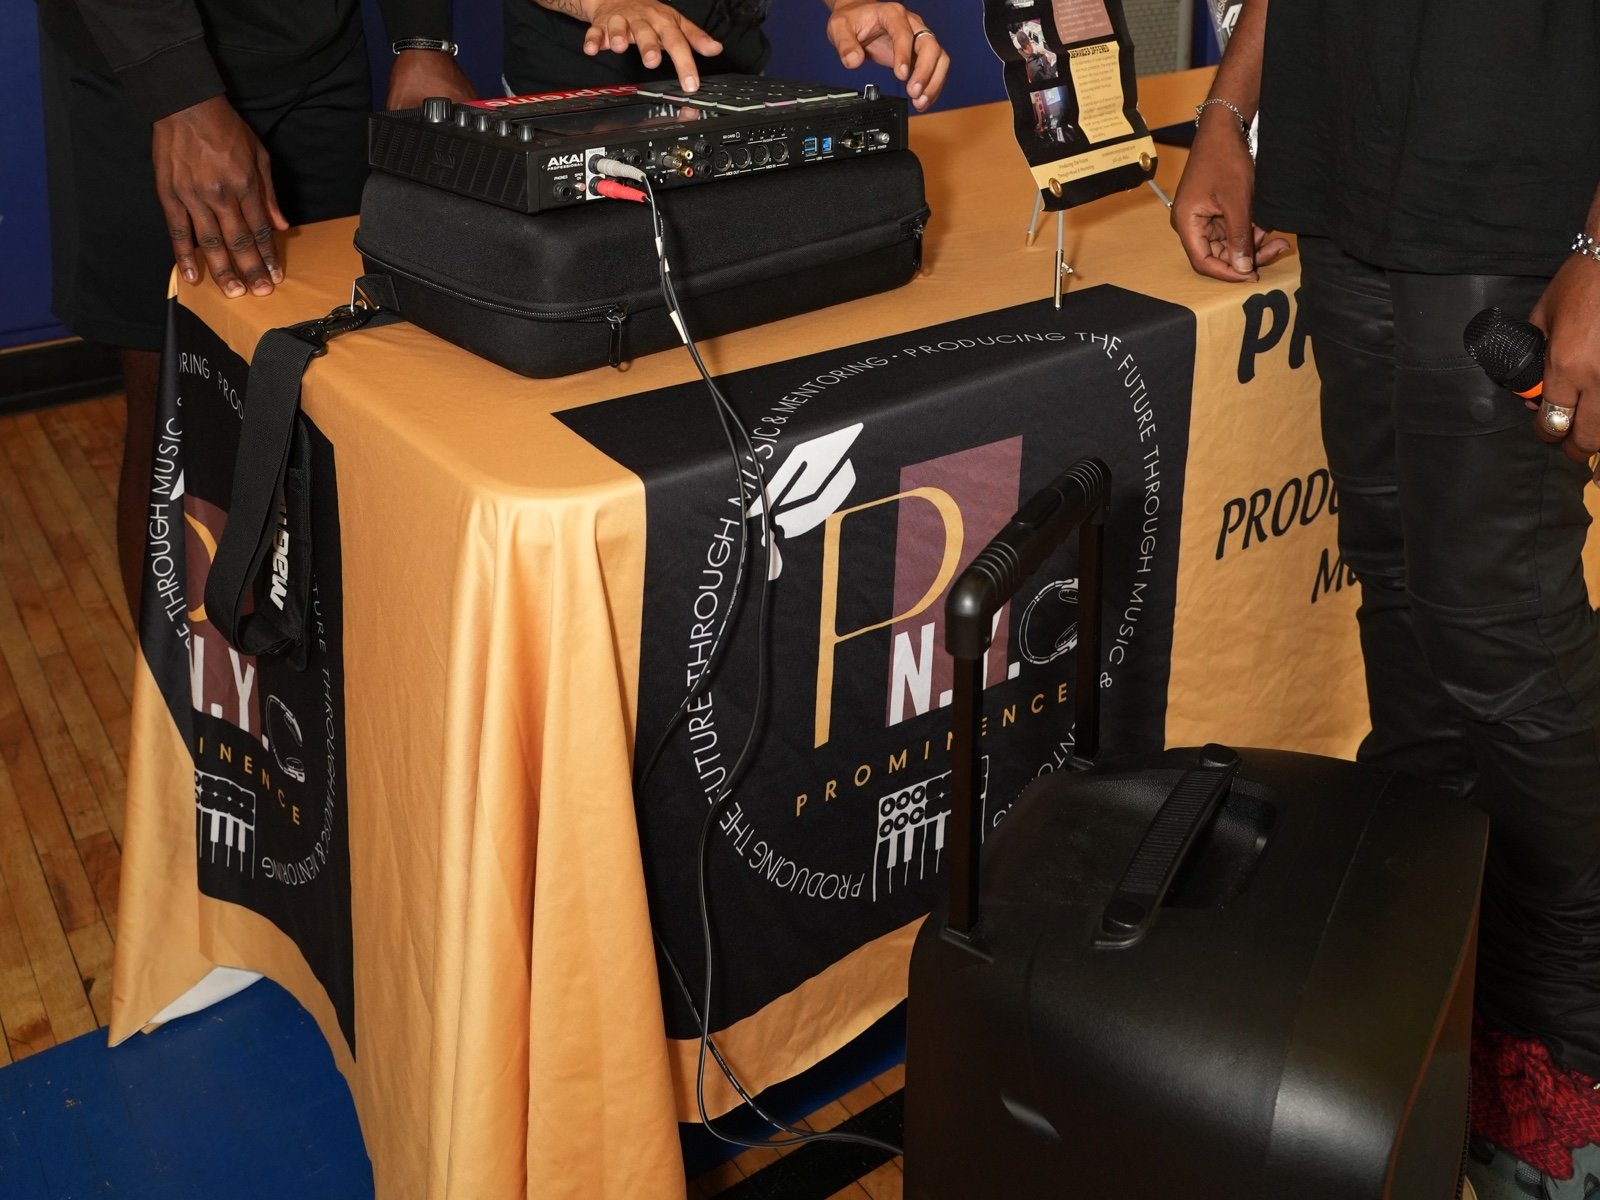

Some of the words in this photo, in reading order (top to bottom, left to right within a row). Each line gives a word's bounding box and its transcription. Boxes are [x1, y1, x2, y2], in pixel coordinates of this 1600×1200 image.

[547, 153, 584, 168] AKAI
[903, 331, 1066, 358] PRODUCING
[1074, 332, 1122, 359] THE
[770, 356, 889, 413] MENTORING
[1117, 353, 1156, 443] FUTURE
[761, 415, 790, 426] &
[151, 417, 183, 495] MUSIC
[1136, 444, 1161, 574] THROUGH
[149, 503, 187, 622] THROUGH
[312, 573, 327, 653] TURE
[686, 517, 741, 687] THROUGH
[1108, 582, 1148, 666] MUSIC
[719, 802, 755, 857] THE
[749, 840, 866, 900] PRODUCING
